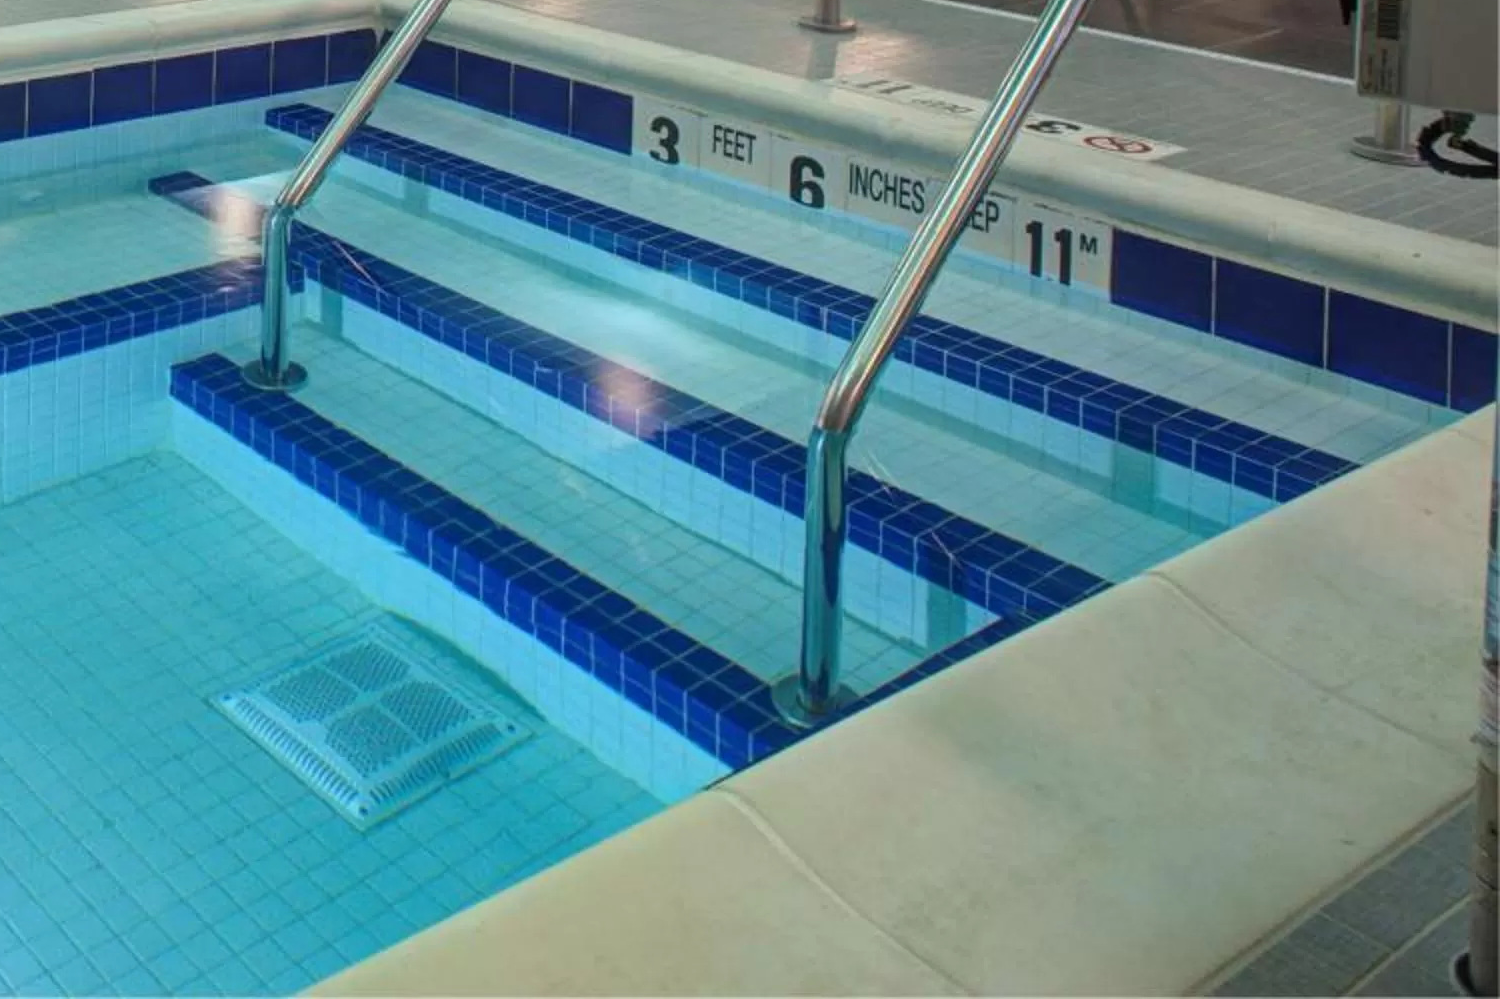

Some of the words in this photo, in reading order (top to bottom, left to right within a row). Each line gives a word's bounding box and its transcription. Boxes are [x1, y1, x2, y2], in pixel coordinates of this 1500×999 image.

[650, 116, 680, 165] 3
[712, 124, 756, 165] FEET
[790, 154, 824, 209] 6
[849, 163, 925, 214] INCHES
